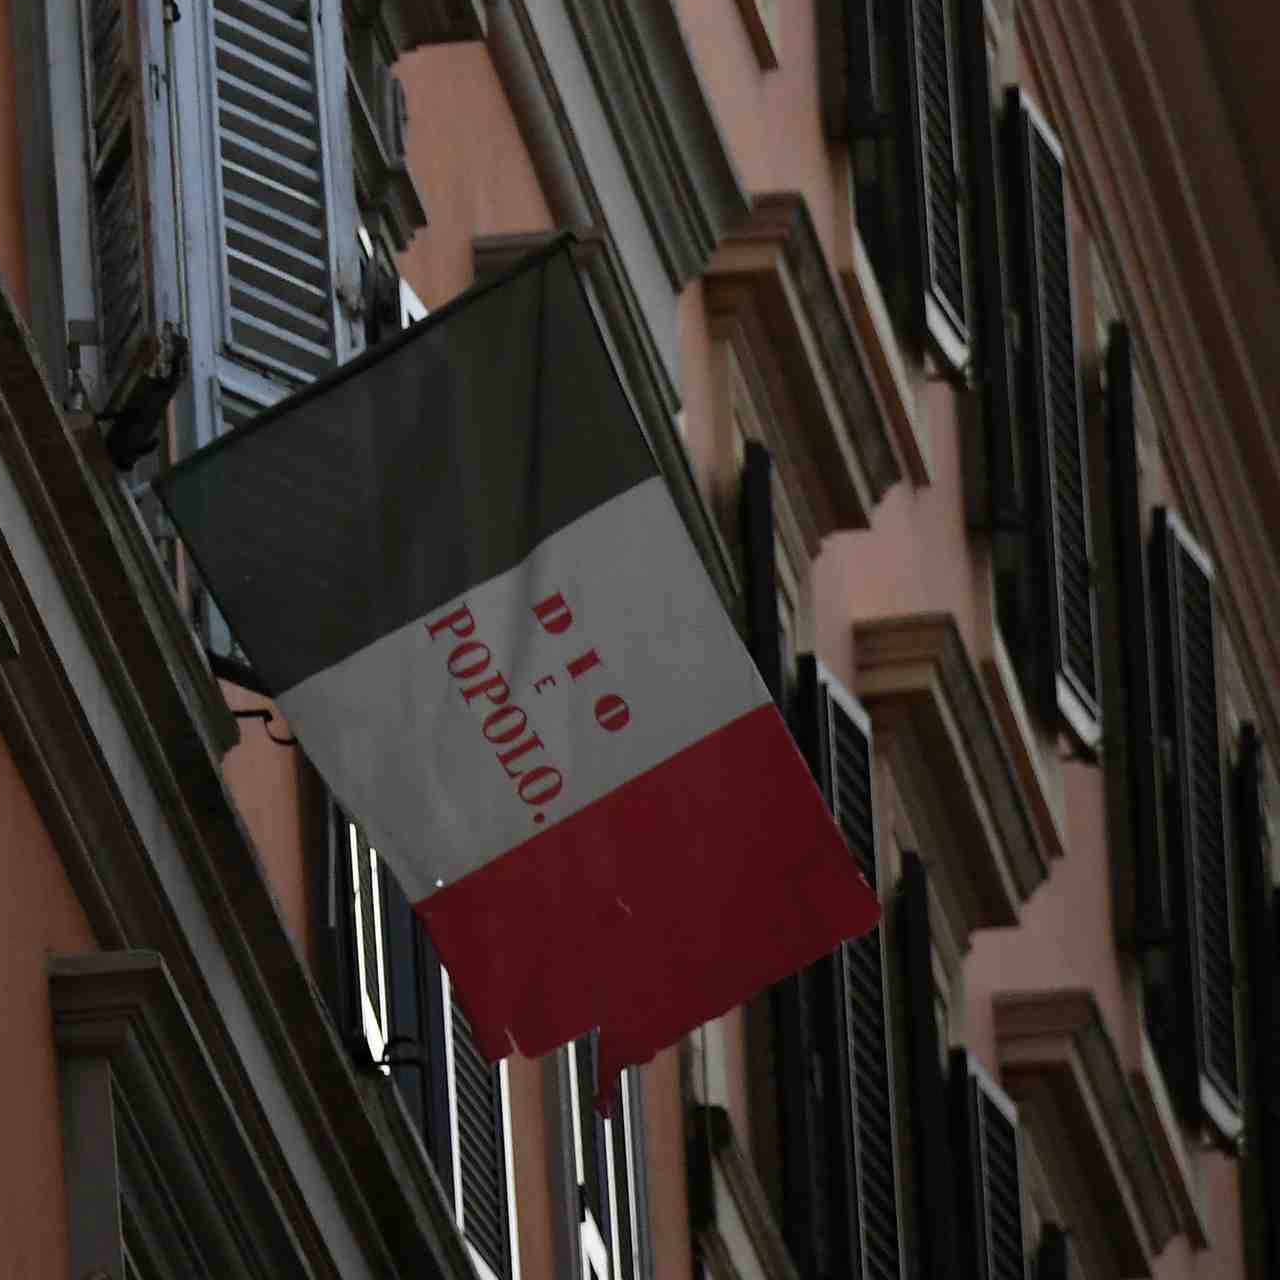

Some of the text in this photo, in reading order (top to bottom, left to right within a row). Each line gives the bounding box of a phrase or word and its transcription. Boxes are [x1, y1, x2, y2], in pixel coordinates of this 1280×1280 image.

[425, 602, 562, 823] POPOLO.
[533, 593, 629, 731] DIO
[534, 675, 556, 694] E
